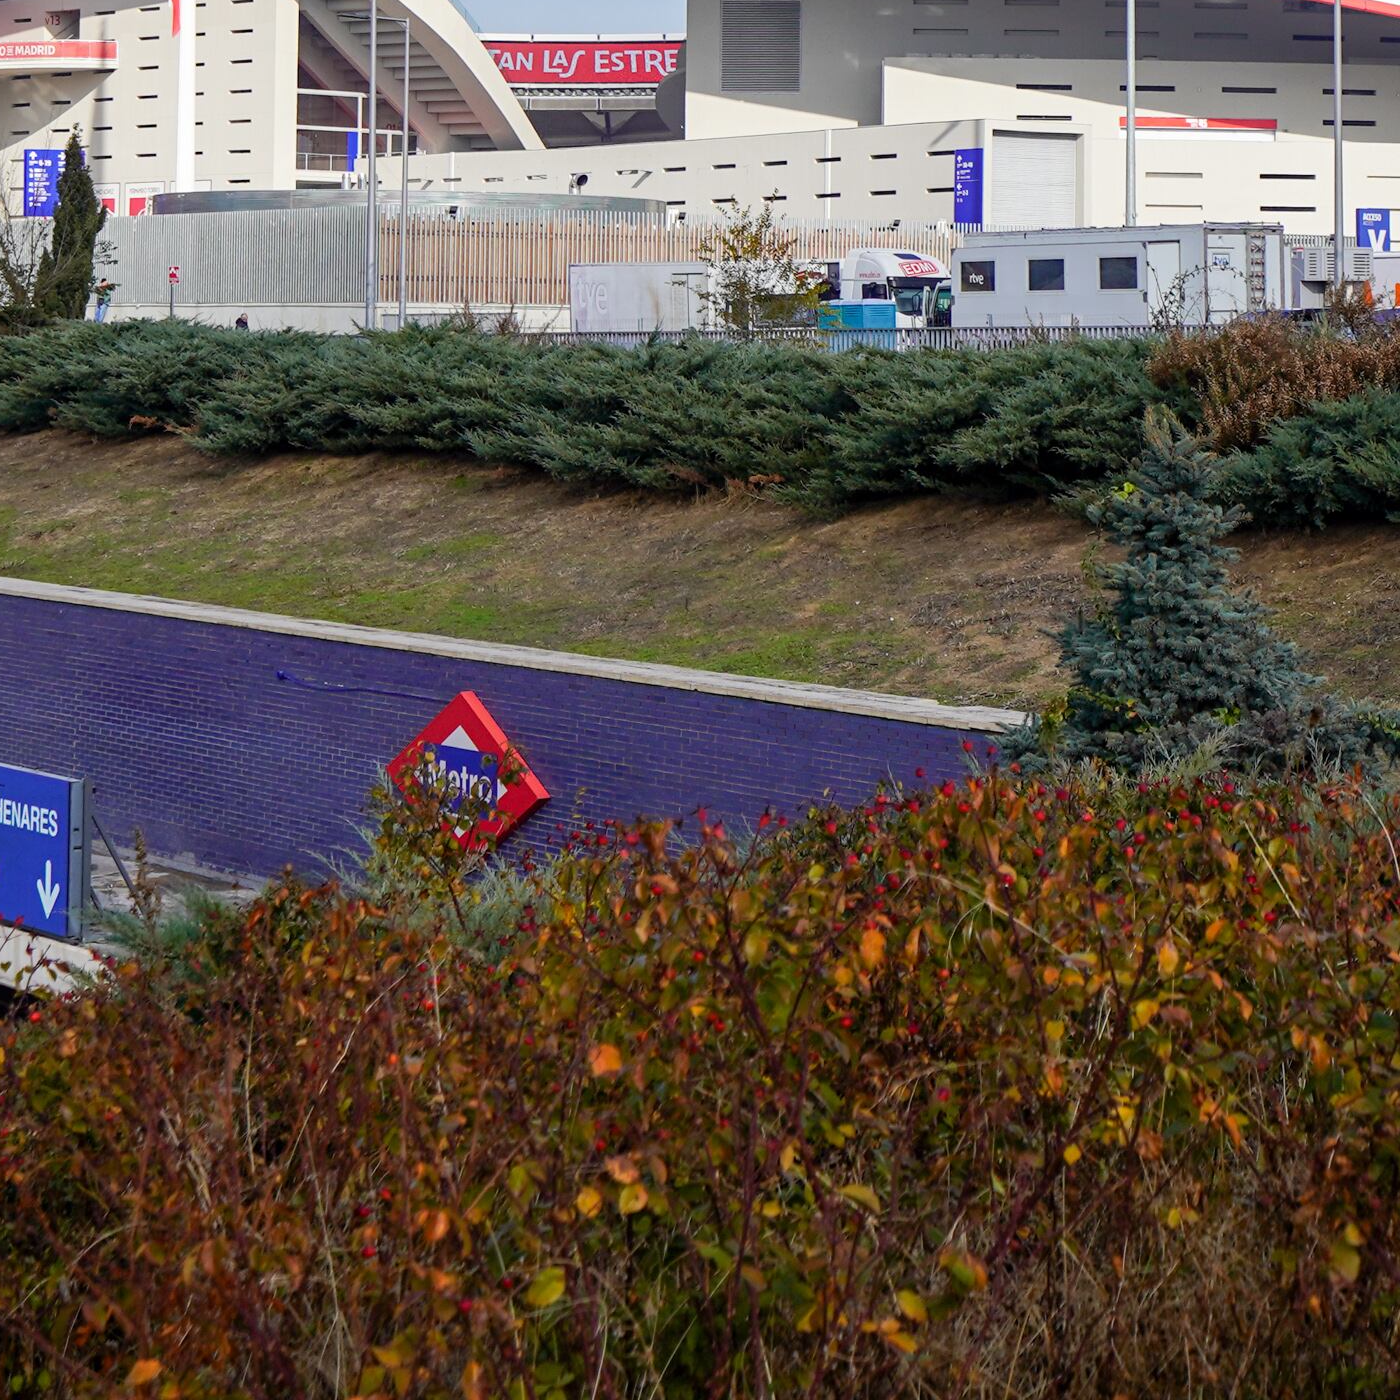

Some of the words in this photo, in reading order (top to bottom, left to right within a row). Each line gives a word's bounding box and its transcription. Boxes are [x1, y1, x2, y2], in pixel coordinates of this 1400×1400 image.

[45, 15, 61, 26] v13
[15, 45, 55, 56] MADRID
[543, 50, 586, 78] LAS
[903, 262, 936, 275] EDMI
[969, 273, 985, 285] rtve
